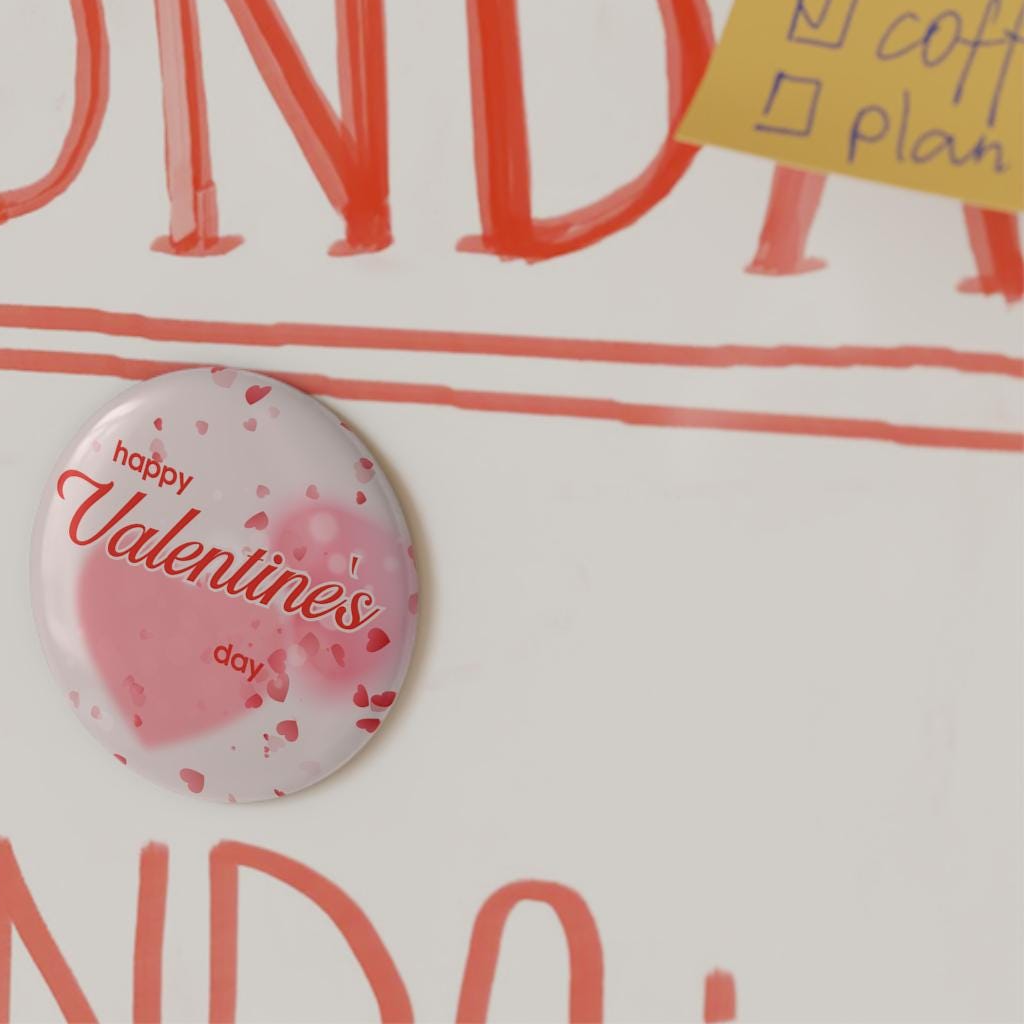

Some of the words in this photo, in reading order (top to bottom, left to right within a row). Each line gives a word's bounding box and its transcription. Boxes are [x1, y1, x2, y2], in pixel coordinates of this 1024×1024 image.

[847, 88, 1011, 174] plan
[112, 439, 194, 496] happy
[56, 468, 382, 632] Valentine's
[212, 643, 265, 683] day
